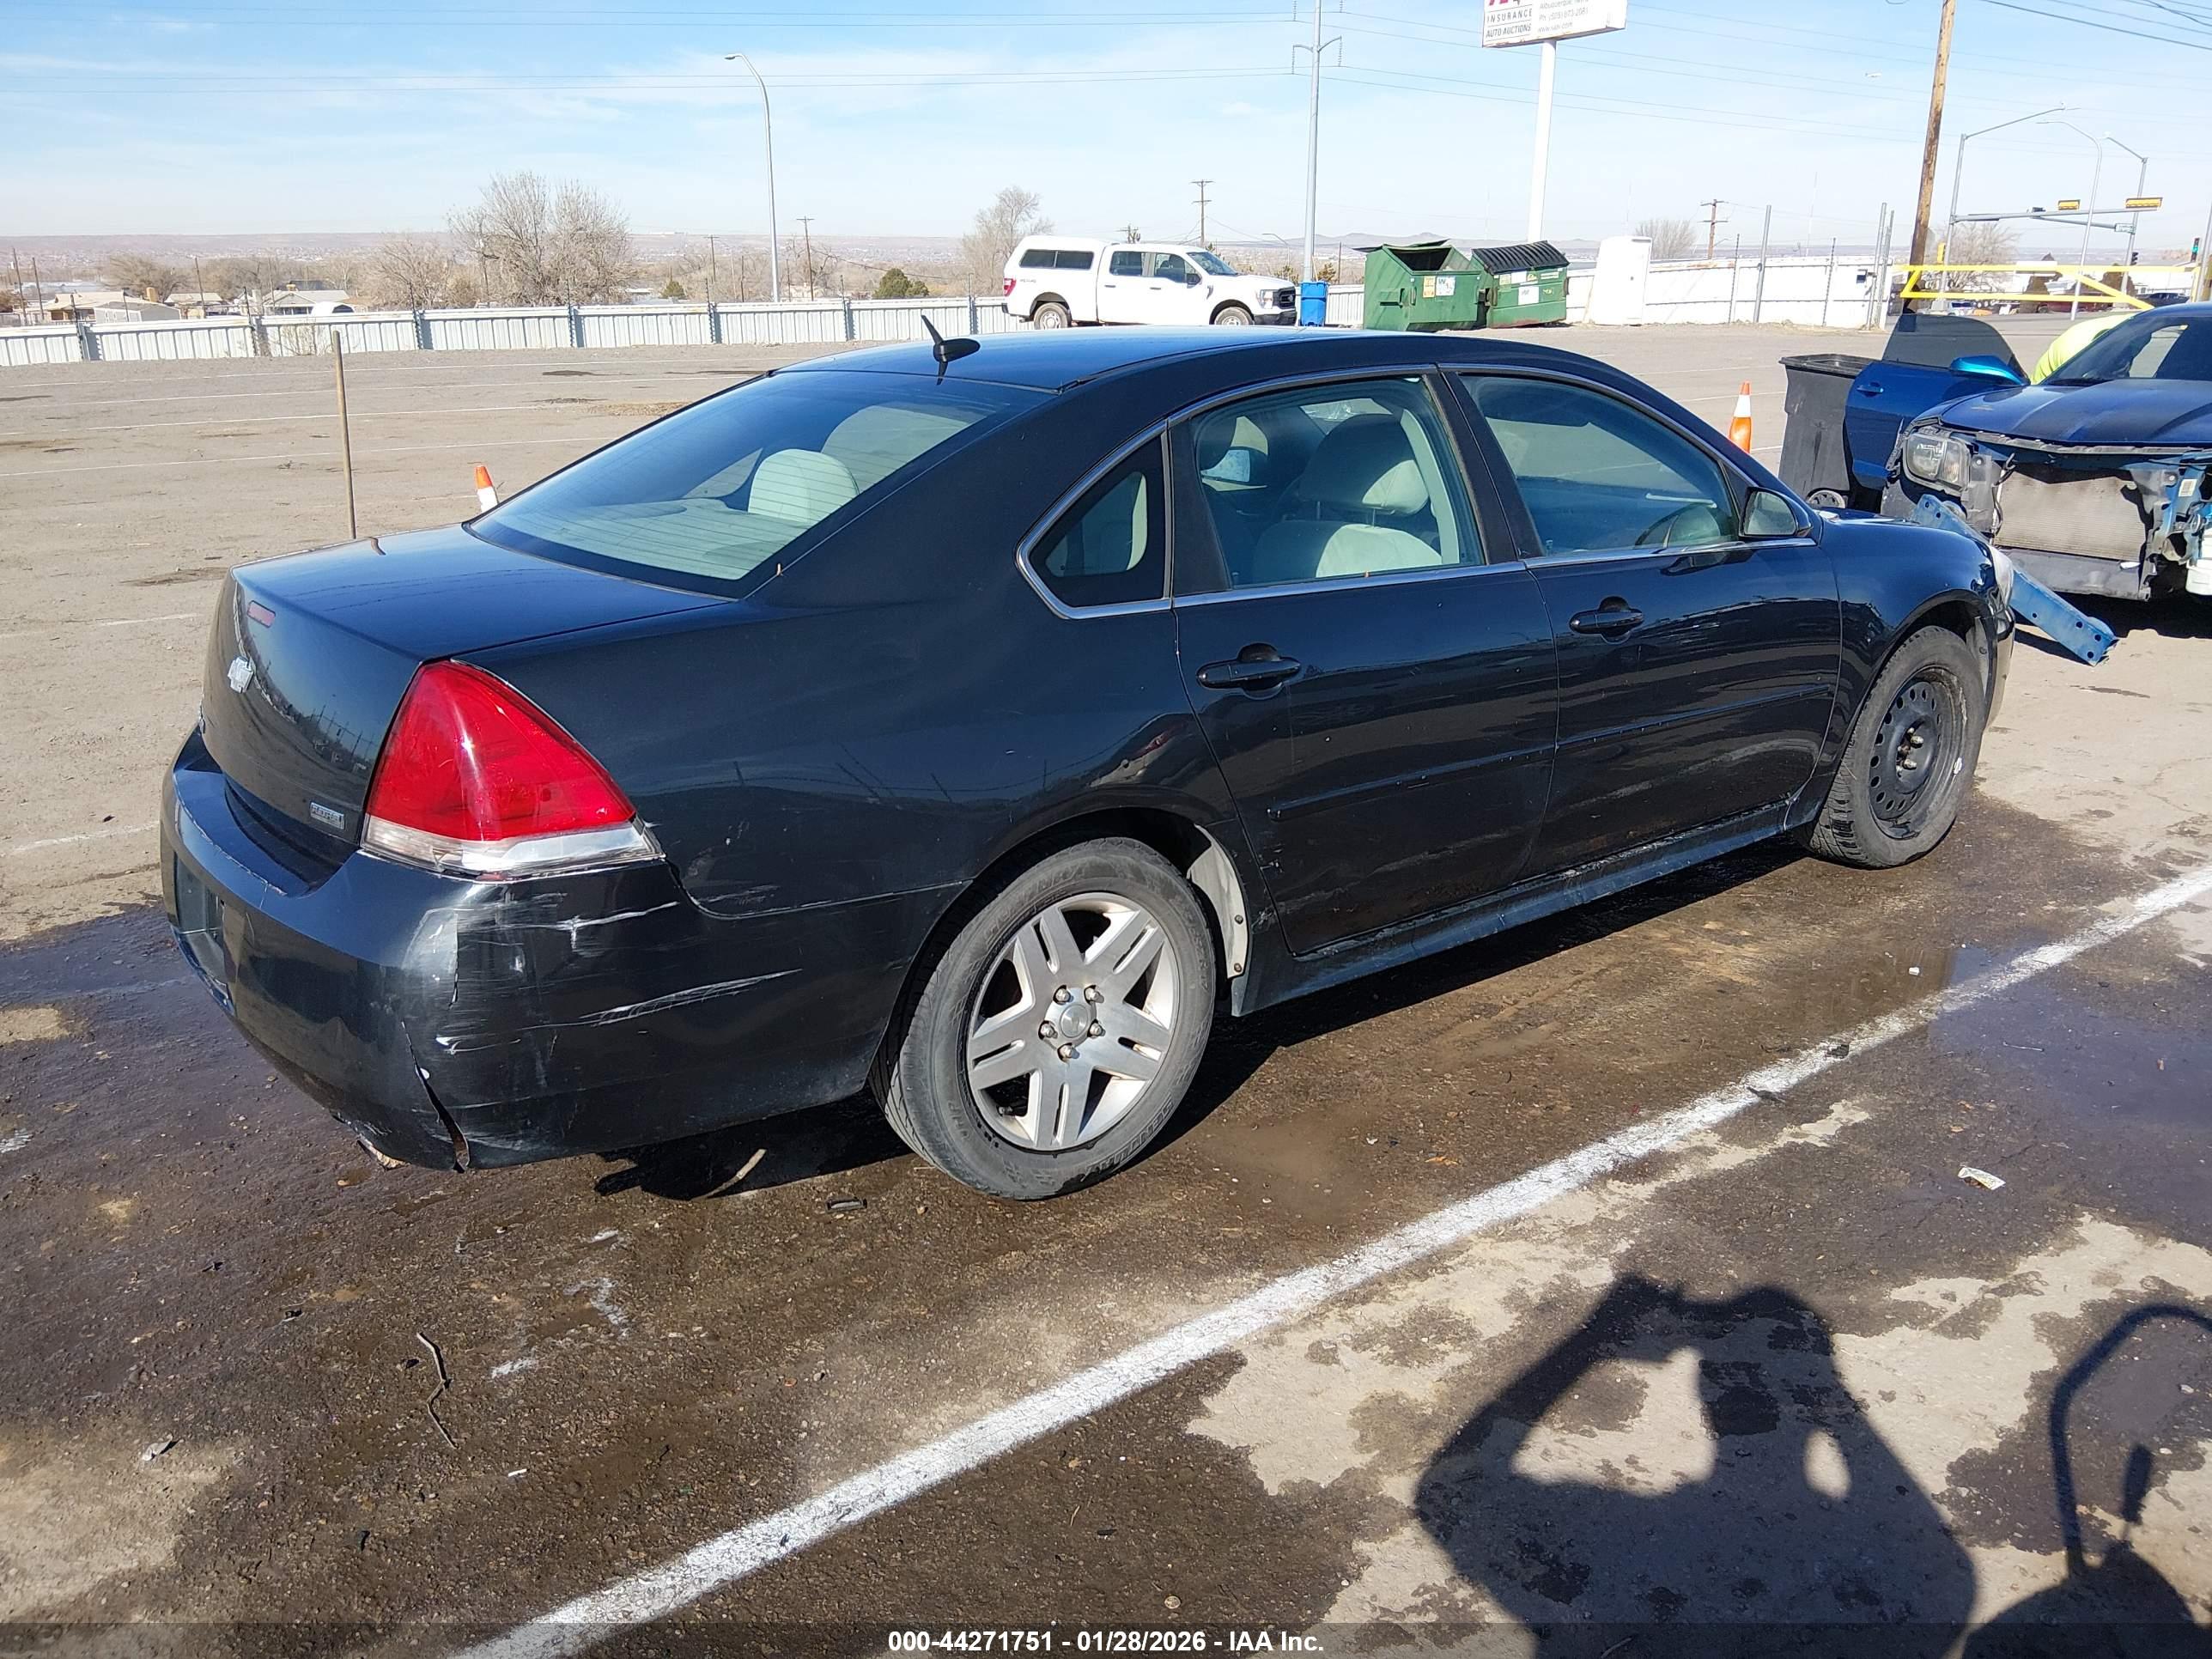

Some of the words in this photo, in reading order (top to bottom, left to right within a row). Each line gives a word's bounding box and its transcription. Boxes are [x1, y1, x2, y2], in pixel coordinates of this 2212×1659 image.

[1486, 8, 1533, 23] INSURANCE
[1486, 27, 1502, 38] AUTO
[1503, 23, 1532, 35] AUCTIONS
